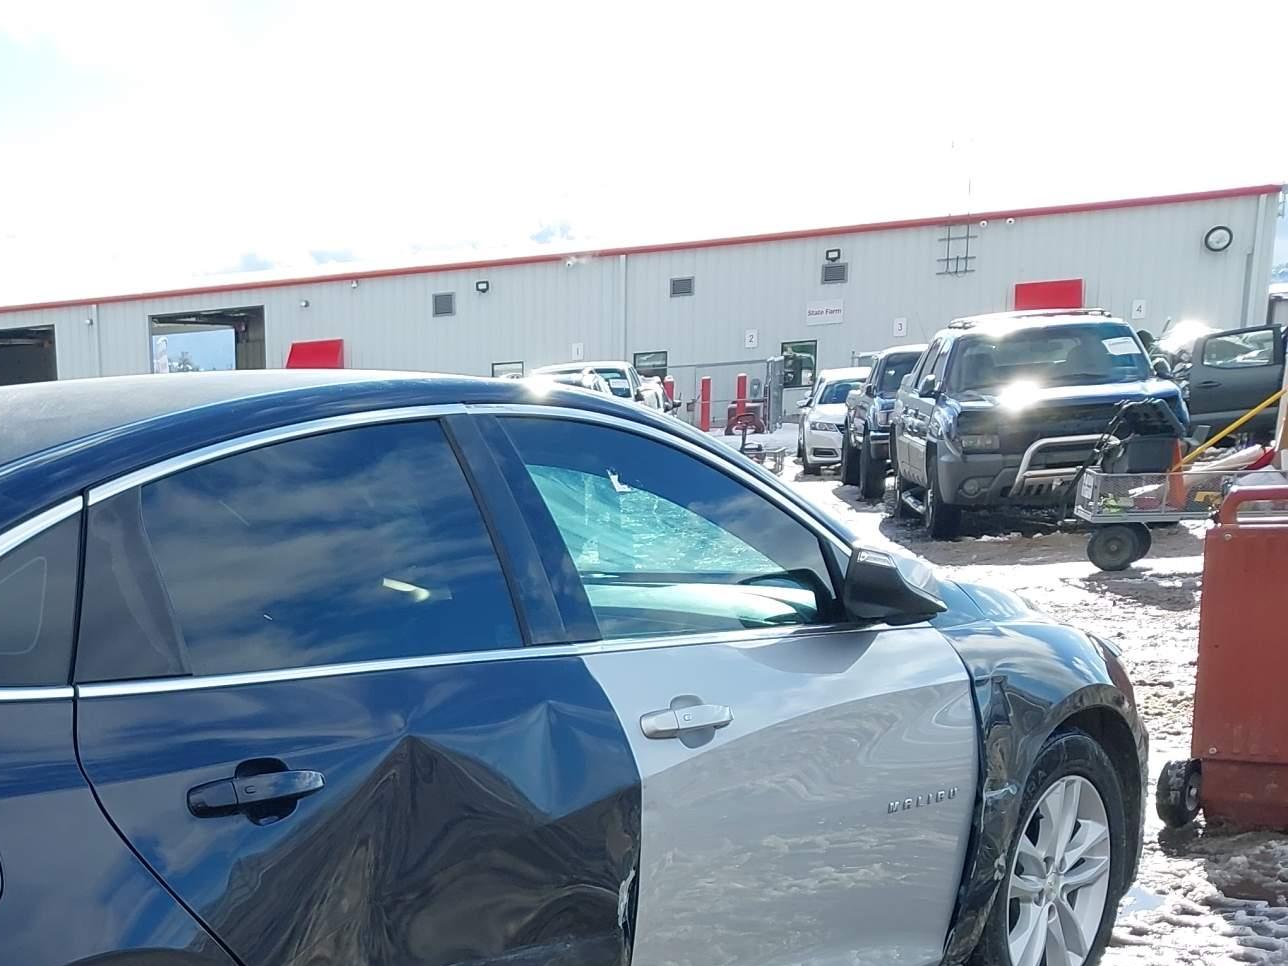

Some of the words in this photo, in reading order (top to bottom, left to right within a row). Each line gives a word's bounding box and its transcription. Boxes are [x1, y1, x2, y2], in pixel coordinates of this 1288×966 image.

[807, 309, 824, 317] State
[825, 308, 842, 316] Farm
[1135, 304, 1142, 313] 4
[897, 322, 903, 332] 3
[748, 334, 754, 344] 2
